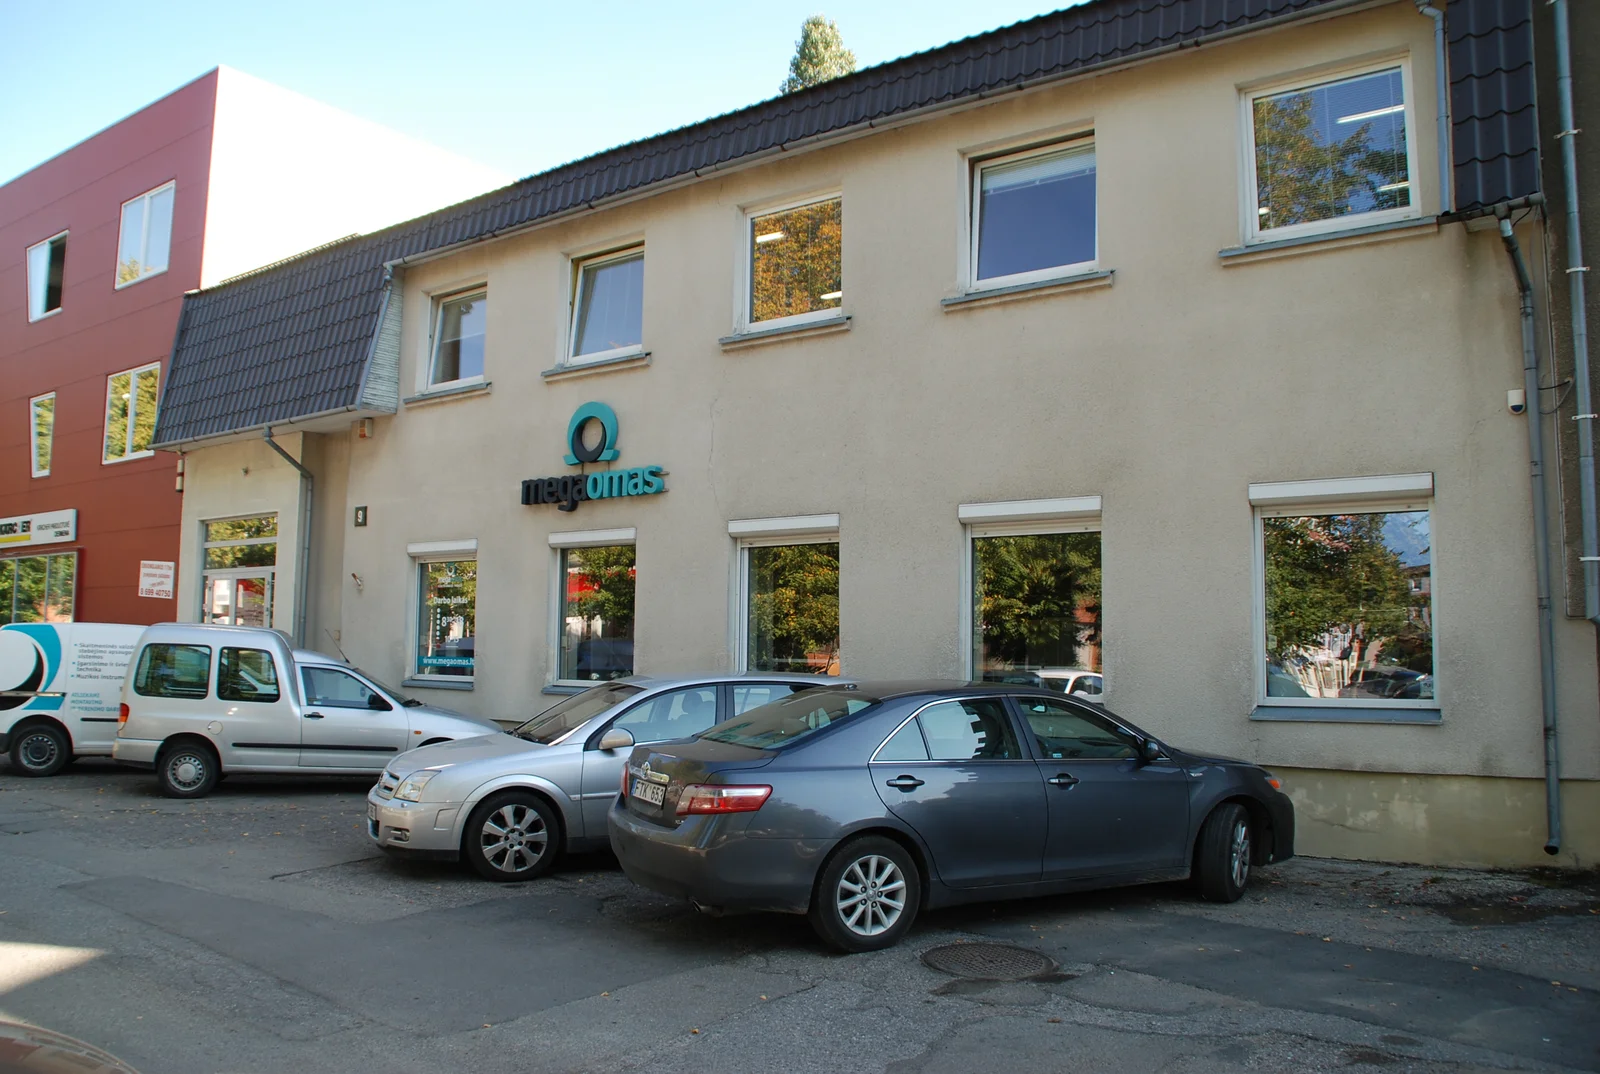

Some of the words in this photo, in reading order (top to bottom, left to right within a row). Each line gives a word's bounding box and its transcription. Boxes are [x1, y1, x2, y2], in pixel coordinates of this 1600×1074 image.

[521, 465, 665, 512] megaomas
[357, 510, 362, 522] 9
[635, 781, 650, 799] FTK
